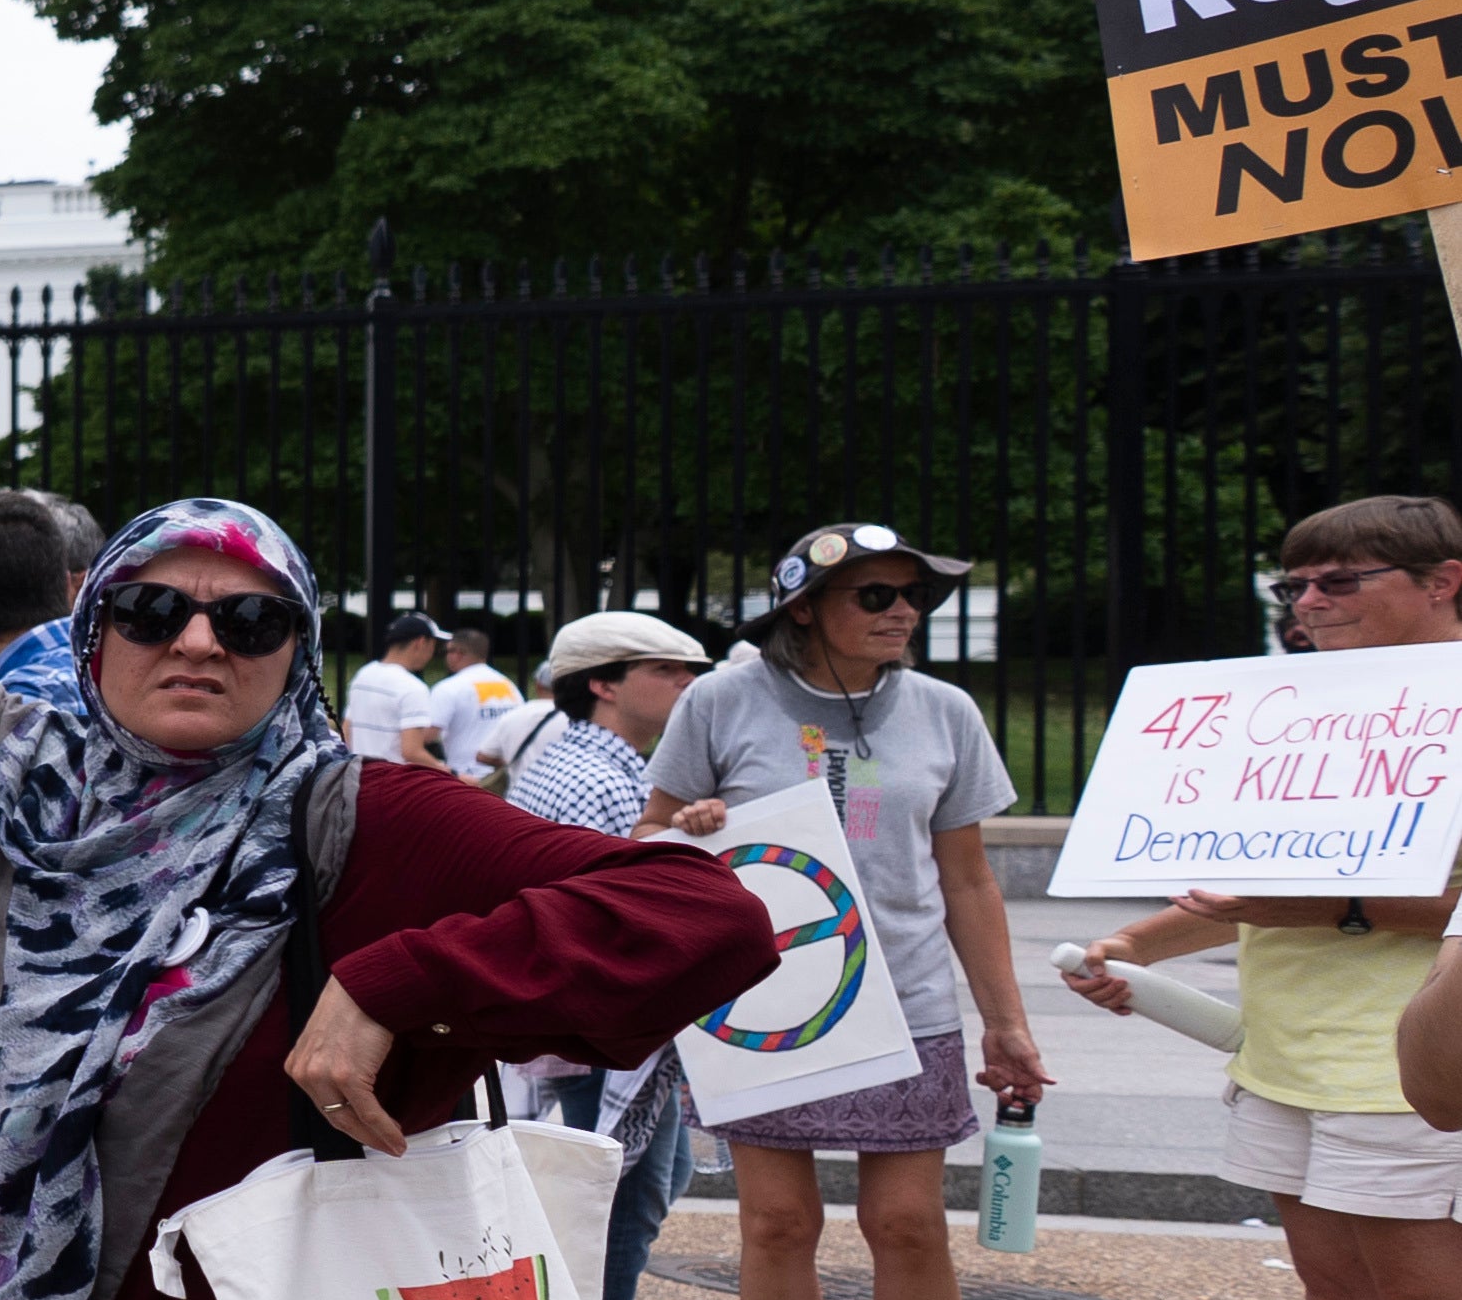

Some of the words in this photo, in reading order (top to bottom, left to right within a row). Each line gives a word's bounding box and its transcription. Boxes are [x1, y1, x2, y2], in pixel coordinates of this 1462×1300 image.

[1141, 692, 1232, 750] 47's
[1165, 765, 1205, 804] is
[1234, 743, 1448, 802] KILLING
[1115, 802, 1425, 876] Democracy!!
